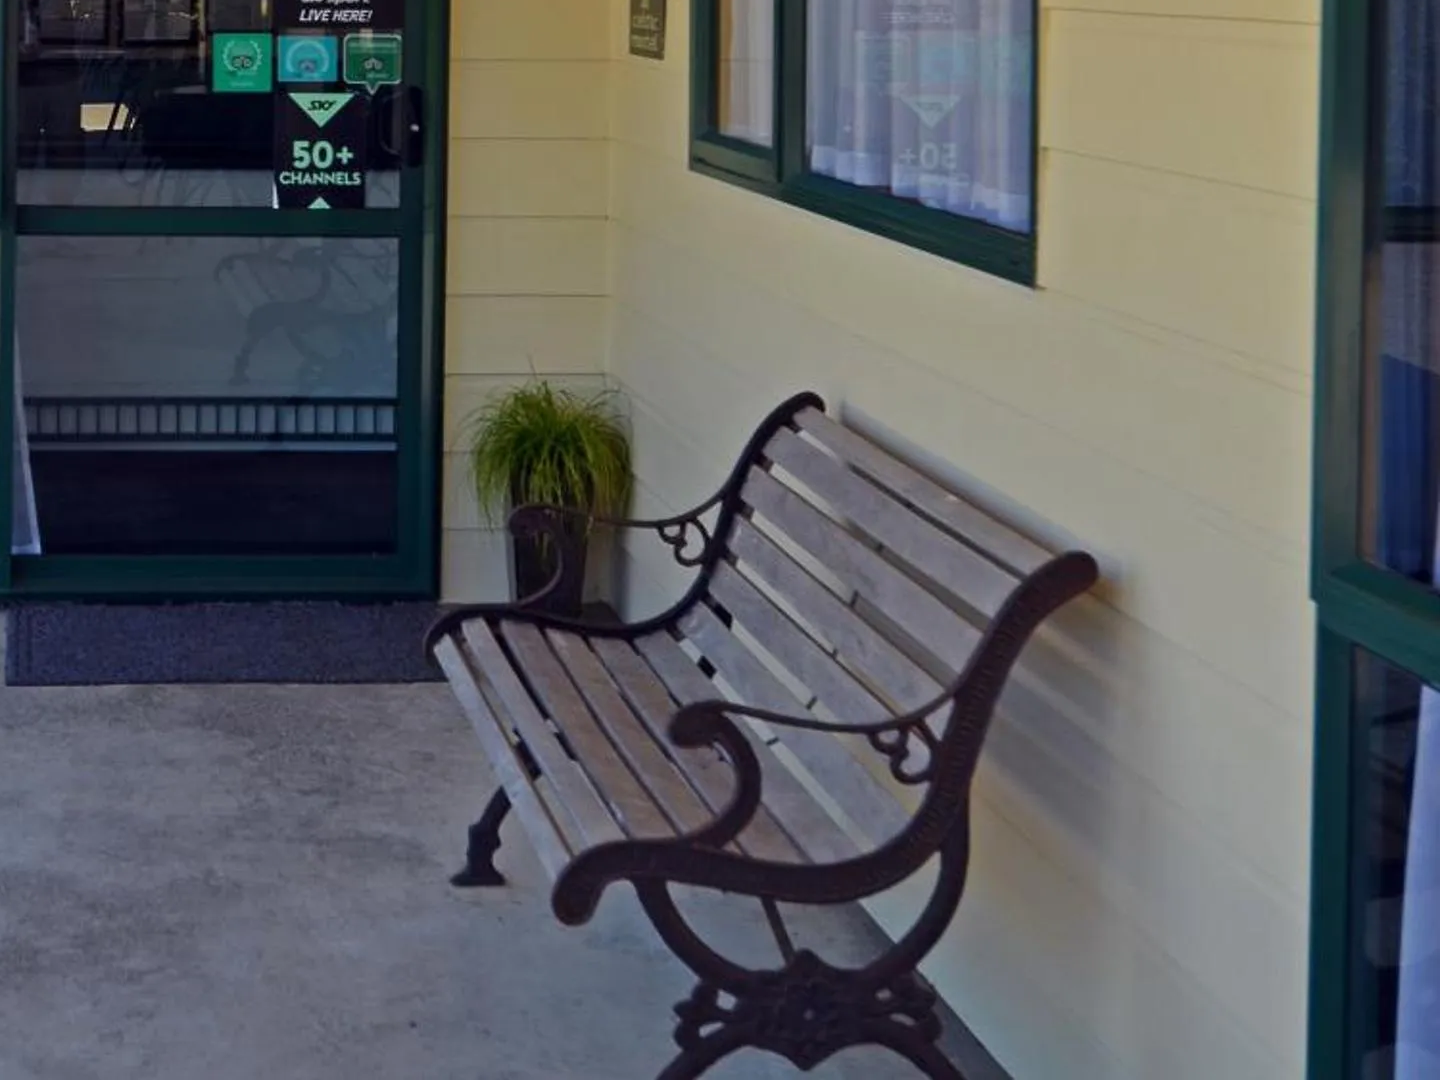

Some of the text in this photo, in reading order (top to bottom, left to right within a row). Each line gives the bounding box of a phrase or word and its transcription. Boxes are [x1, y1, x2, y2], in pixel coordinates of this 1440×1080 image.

[299, 9, 374, 23] LIVE HERE!
[293, 140, 354, 169] 50+
[279, 171, 362, 186] CHANNELS
